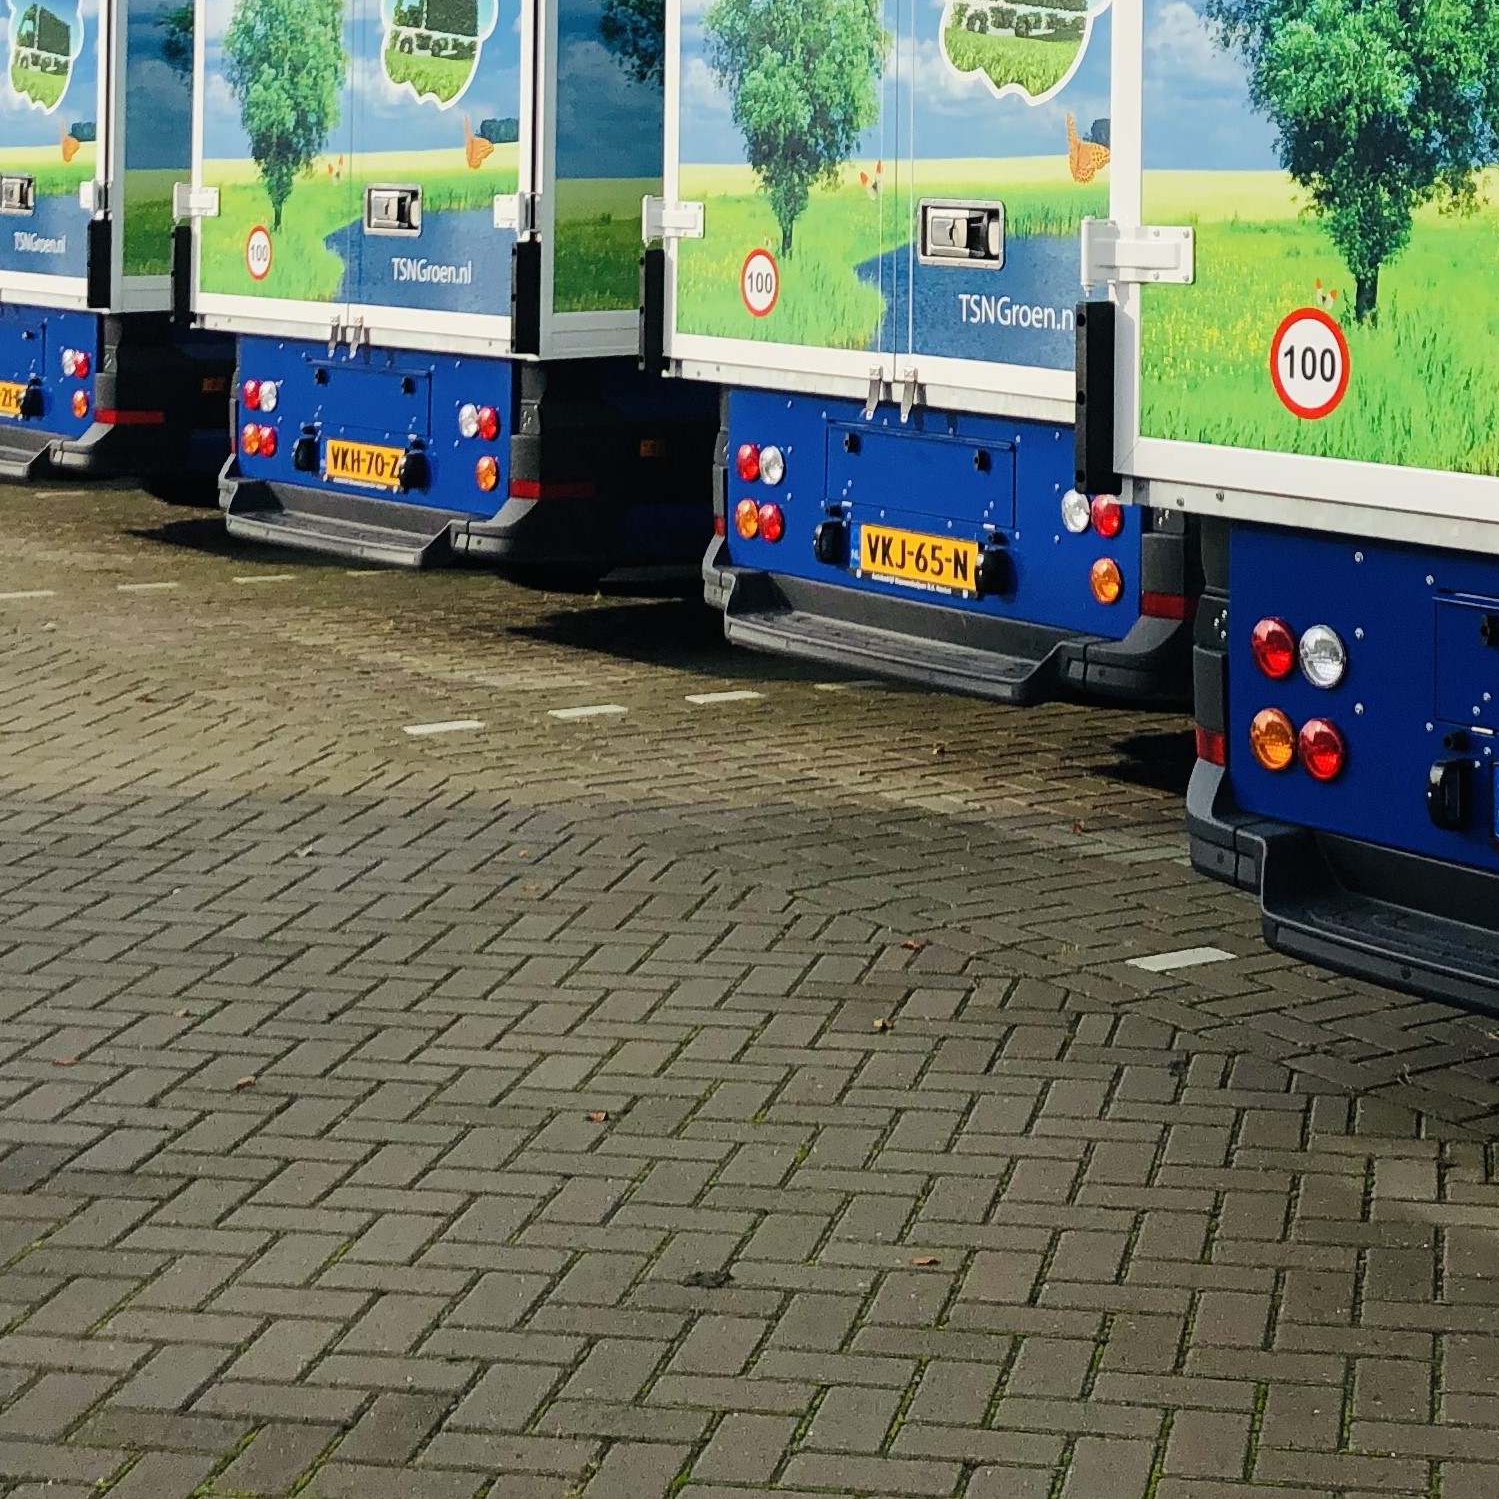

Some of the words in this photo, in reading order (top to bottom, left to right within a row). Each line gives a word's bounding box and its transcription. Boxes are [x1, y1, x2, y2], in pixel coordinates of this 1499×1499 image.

[250, 244, 268, 262] 100
[391, 257, 472, 285] TSNGroen.nl
[746, 269, 773, 296] 100
[1283, 344, 1337, 383] 100
[331, 445, 400, 479] VKH-70-Z
[866, 532, 969, 582] VKJ-65-N
